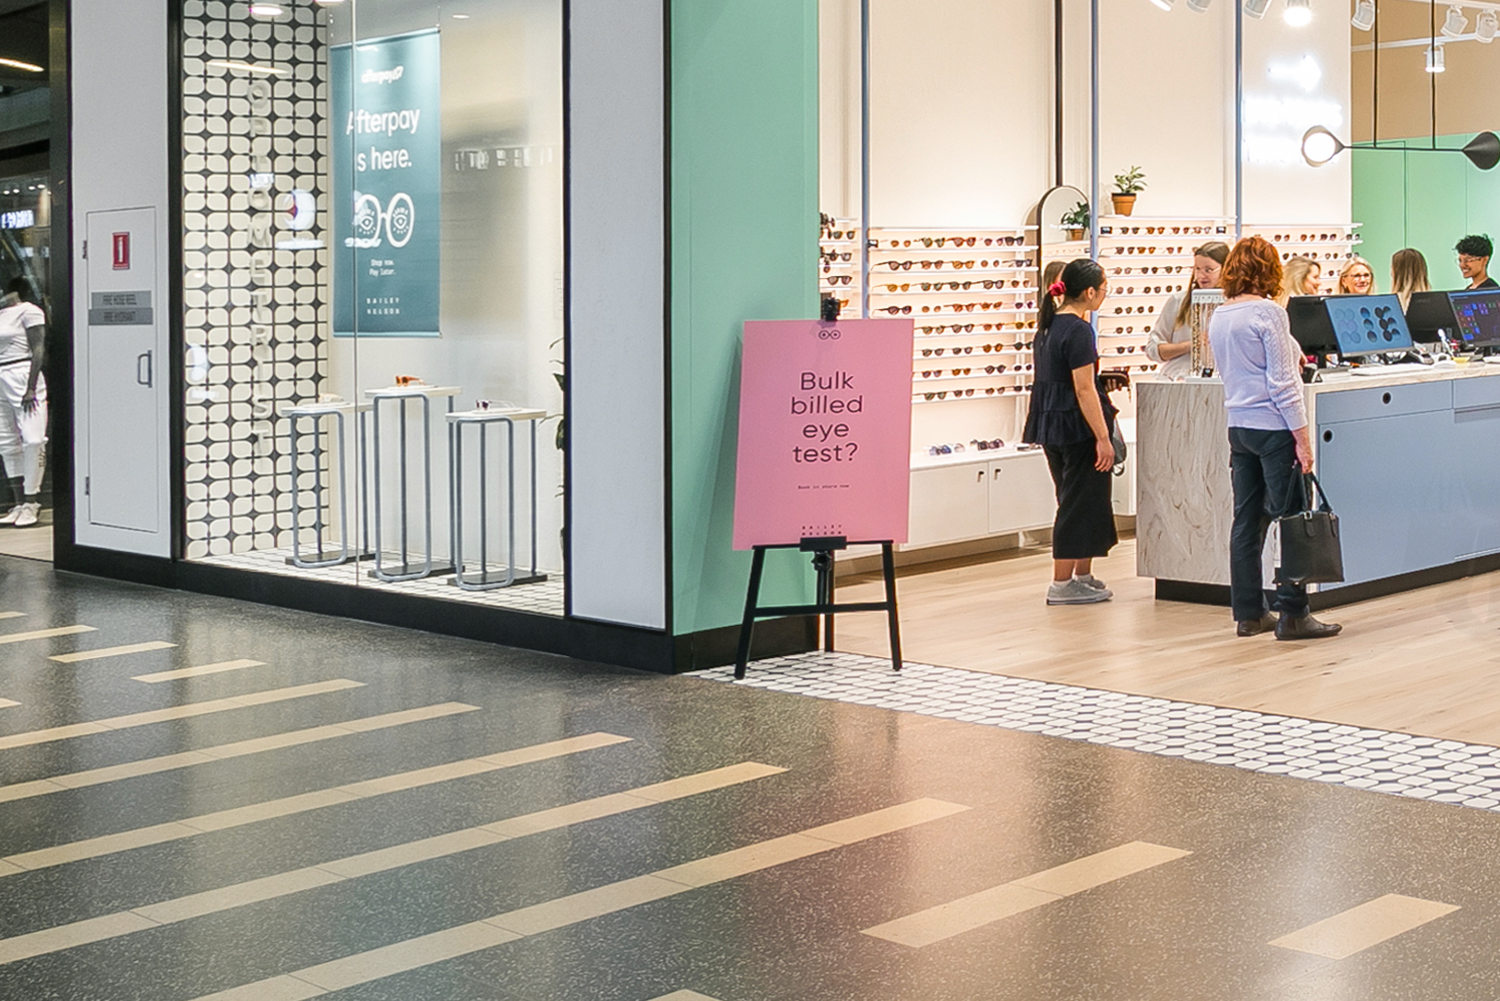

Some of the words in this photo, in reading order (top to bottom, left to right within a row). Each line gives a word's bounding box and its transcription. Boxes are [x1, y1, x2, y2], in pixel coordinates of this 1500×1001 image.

[345, 108, 421, 138] Afterpay
[370, 144, 413, 171] here.
[366, 297, 400, 305] BAILEY
[366, 307, 401, 315] NELSON
[800, 371, 854, 391] Bulk
[790, 395, 863, 416] billed
[802, 422, 850, 443] eye
[792, 442, 858, 463] test?
